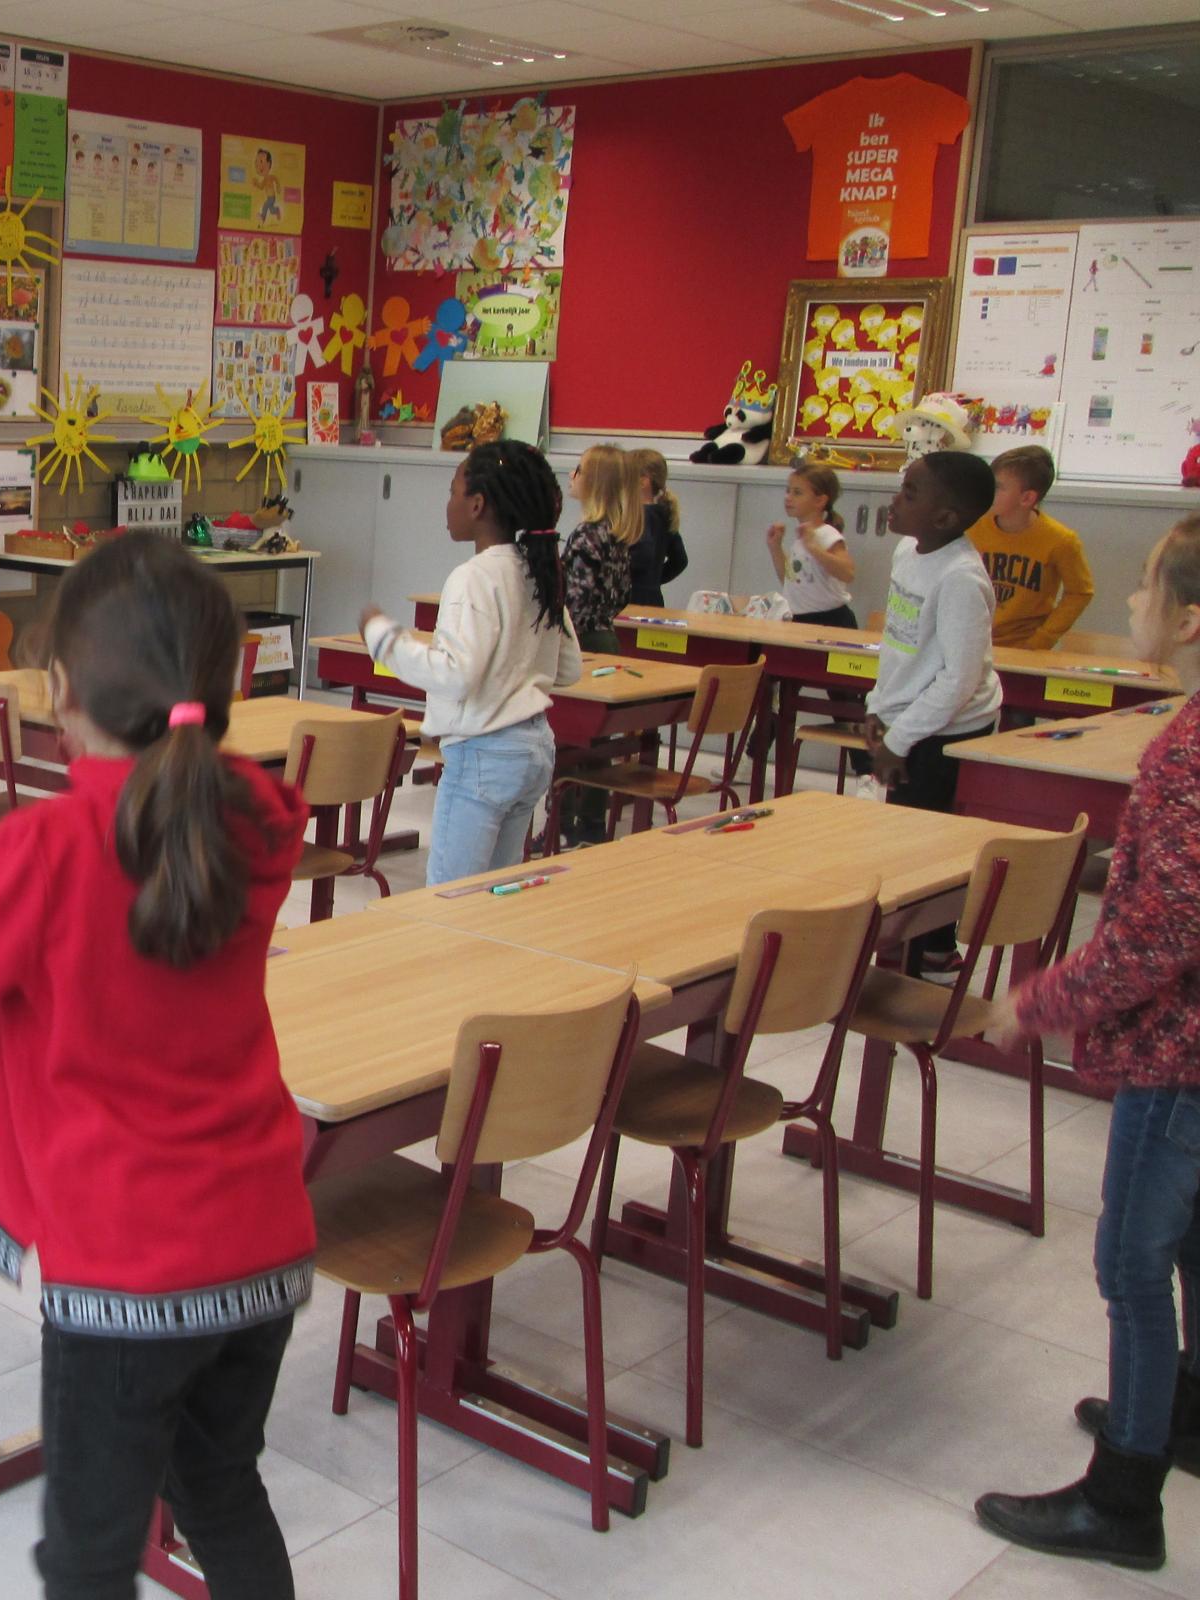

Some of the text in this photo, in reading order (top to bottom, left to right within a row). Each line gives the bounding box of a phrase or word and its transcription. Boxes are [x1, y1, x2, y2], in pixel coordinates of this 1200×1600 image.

[868, 112, 885, 128] Ik
[860, 131, 889, 147] ben
[846, 148, 899, 166] SUPER
[845, 167, 894, 184] MEGA
[839, 185, 888, 202] KNAP
[831, 357, 843, 366] We
[844, 356, 869, 366] landen
[870, 357, 877, 366] in
[160, 506, 176, 520] DAT
[1062, 687, 1091, 698] Robbe
